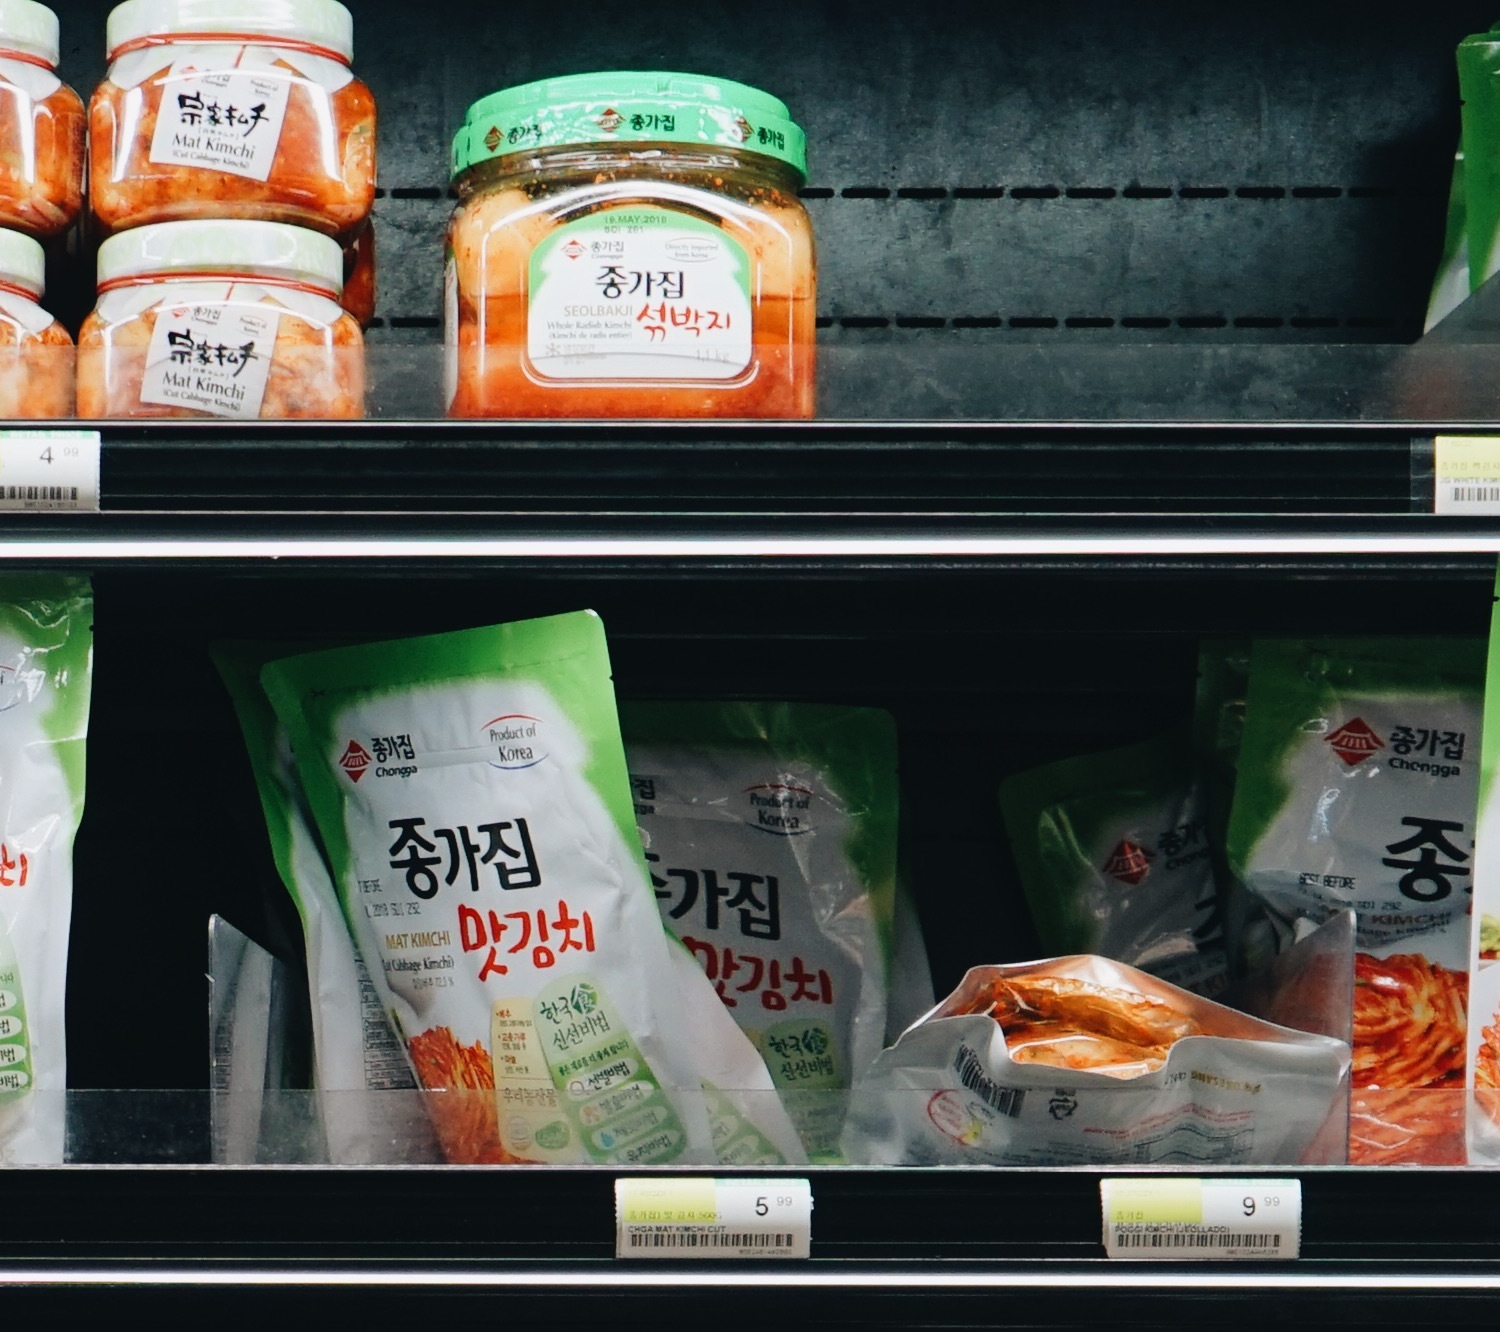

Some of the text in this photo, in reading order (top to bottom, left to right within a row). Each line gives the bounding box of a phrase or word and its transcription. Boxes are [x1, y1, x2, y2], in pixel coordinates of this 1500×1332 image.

[630, 113, 675, 132] 종가집
[595, 264, 686, 299] 종가집
[564, 304, 633, 318] SEOLBAKJI
[39, 445, 79, 466] 4 99
[498, 744, 533, 764] Korea
[375, 764, 418, 780] Chongga
[388, 816, 542, 900] 종가집
[458, 901, 597, 983] 맛김치
[754, 1195, 793, 1217] 5 99
